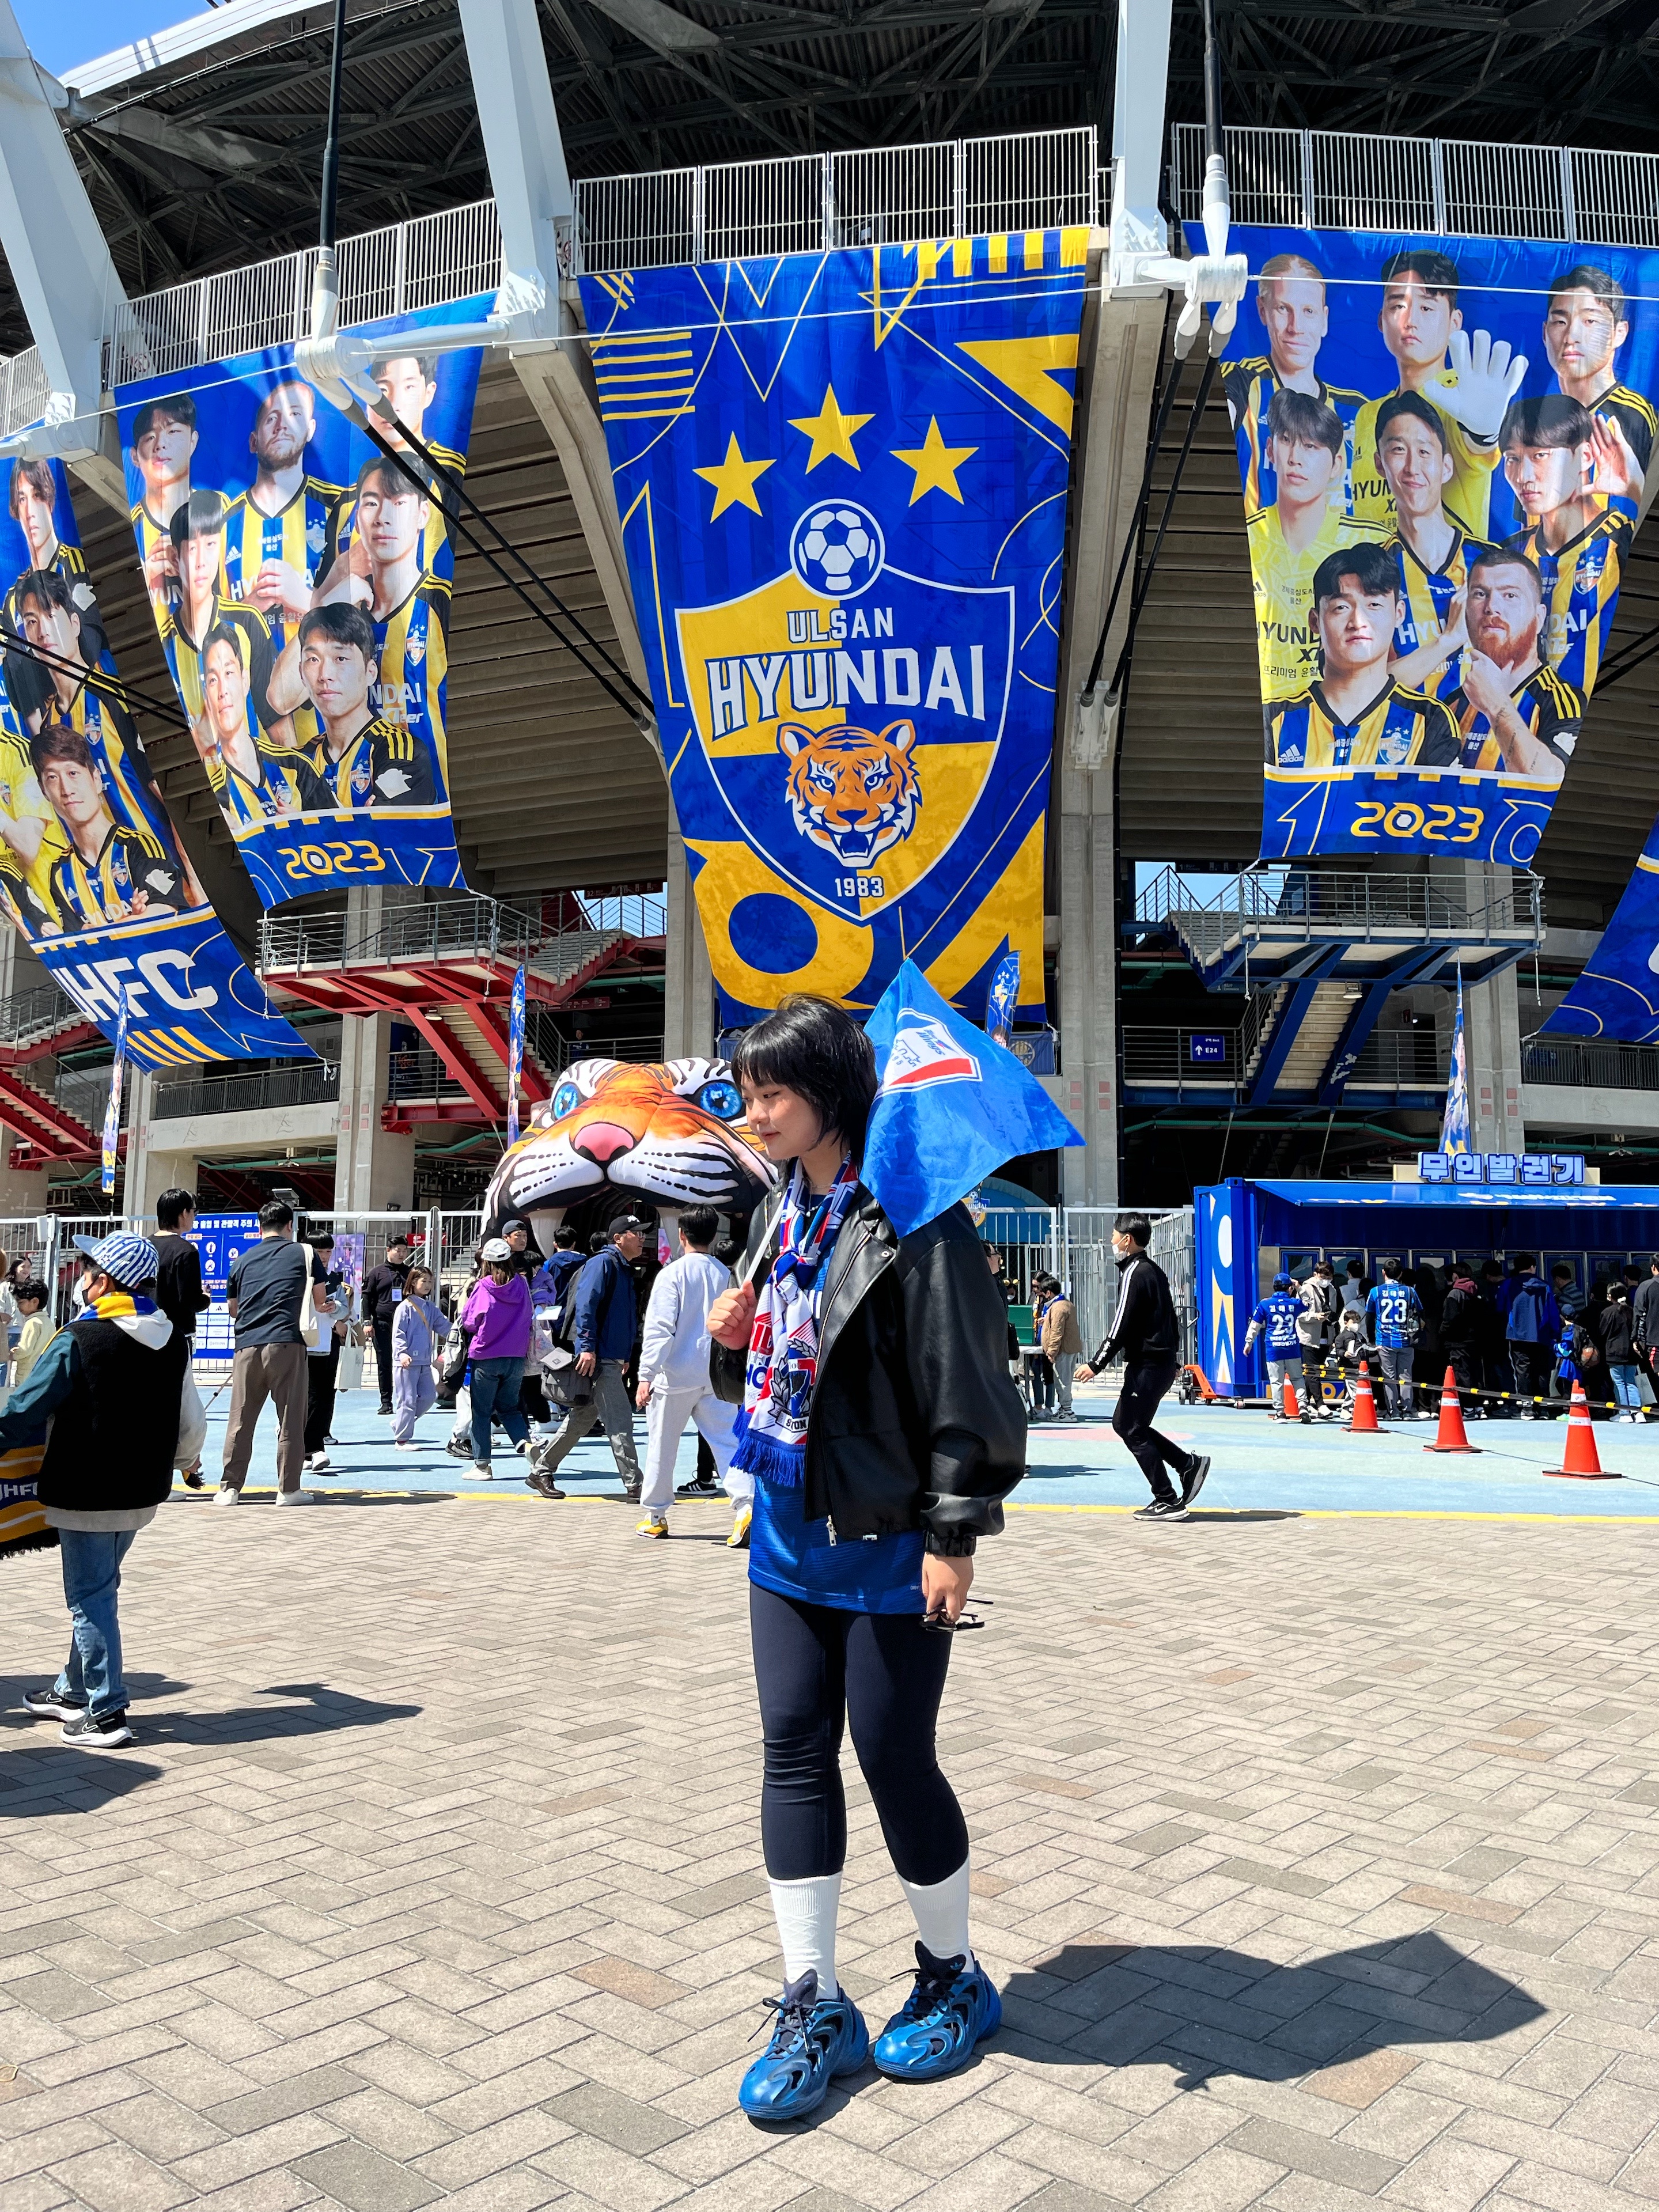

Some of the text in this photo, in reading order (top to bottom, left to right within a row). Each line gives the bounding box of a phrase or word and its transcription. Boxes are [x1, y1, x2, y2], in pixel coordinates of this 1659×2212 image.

[787, 607, 894, 642] ULSAN
[706, 645, 986, 740] HYUNDAI
[1350, 801, 1484, 843] 2023
[276, 840, 386, 879] 2023
[834, 876, 884, 897] 1983
[1418, 1152, 1584, 1184] 무인발권기
[1381, 1299, 1407, 1323] 23
